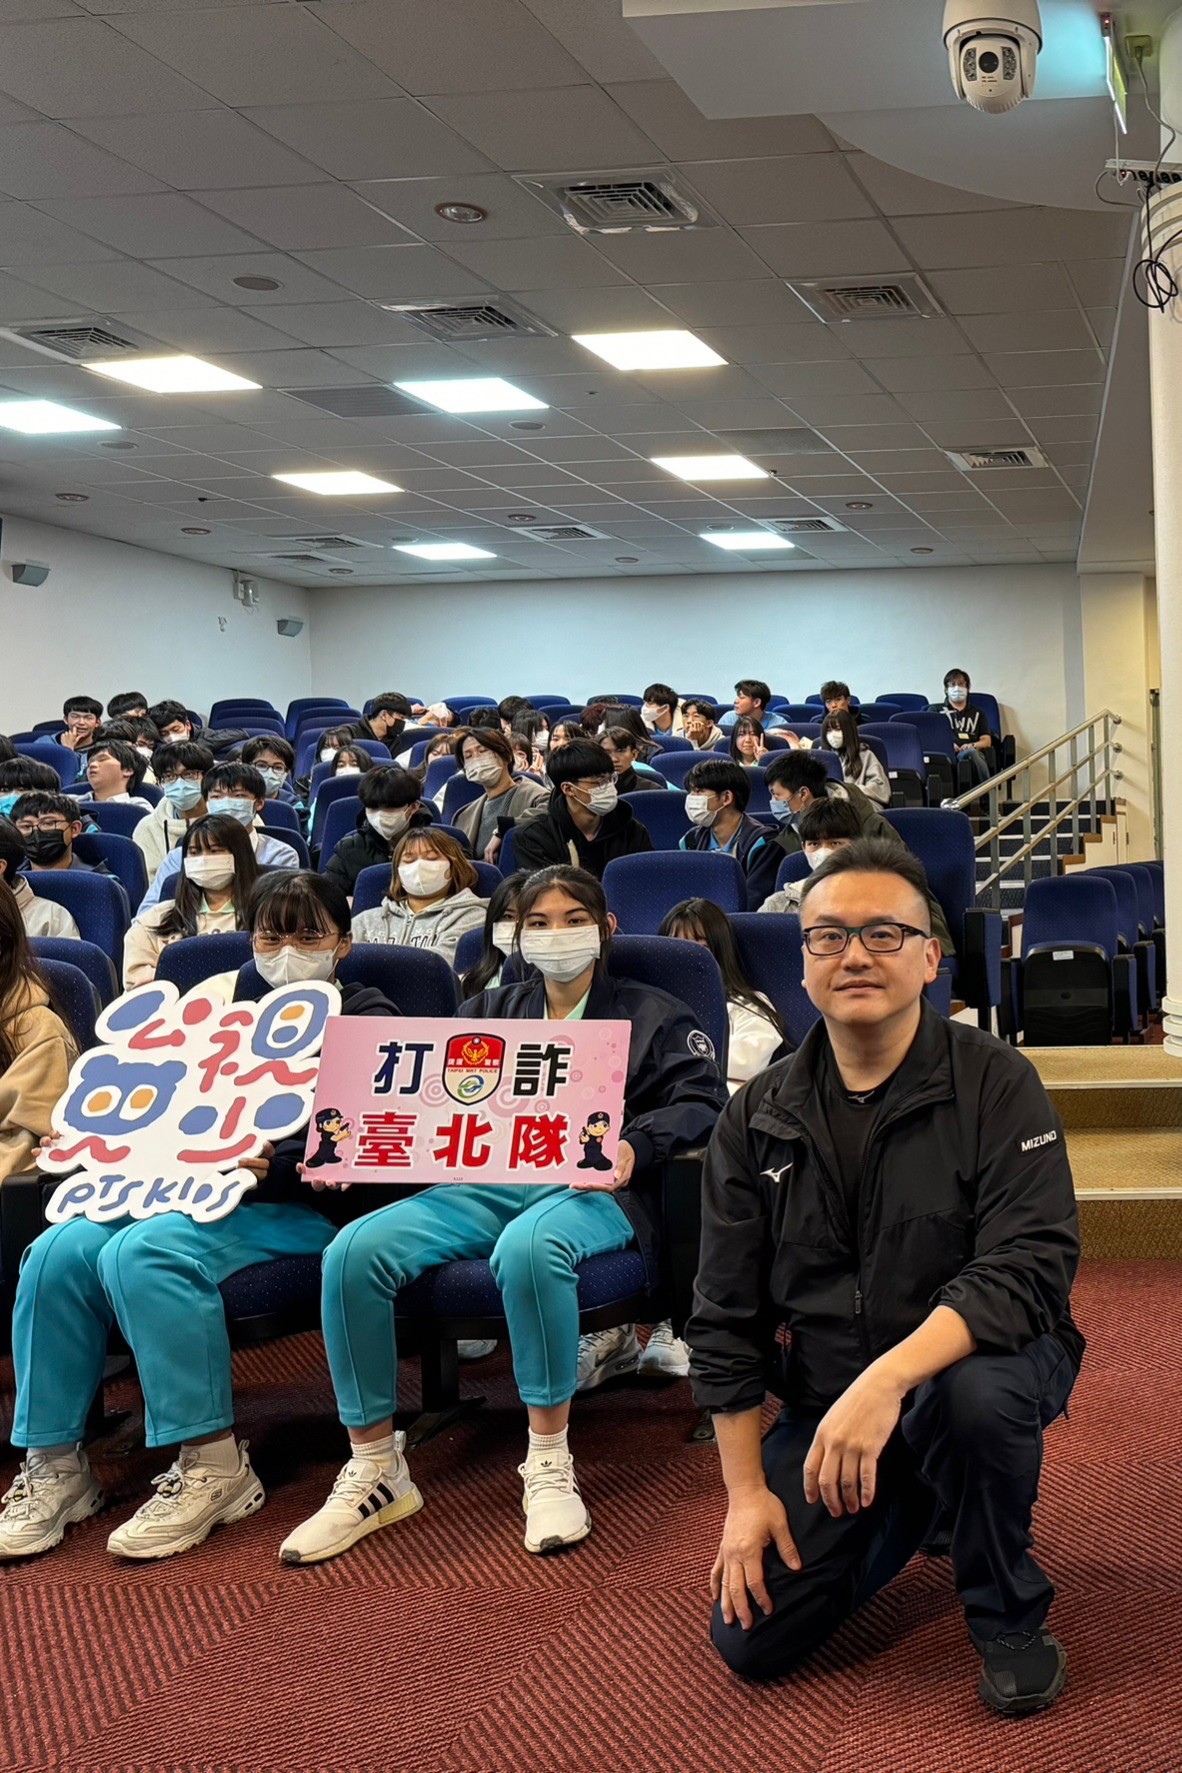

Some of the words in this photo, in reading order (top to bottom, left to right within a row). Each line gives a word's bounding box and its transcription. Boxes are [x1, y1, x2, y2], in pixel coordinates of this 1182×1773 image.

[354, 1111, 569, 1170] 臺北隊
[1020, 1130, 1059, 1152] MIZUNO
